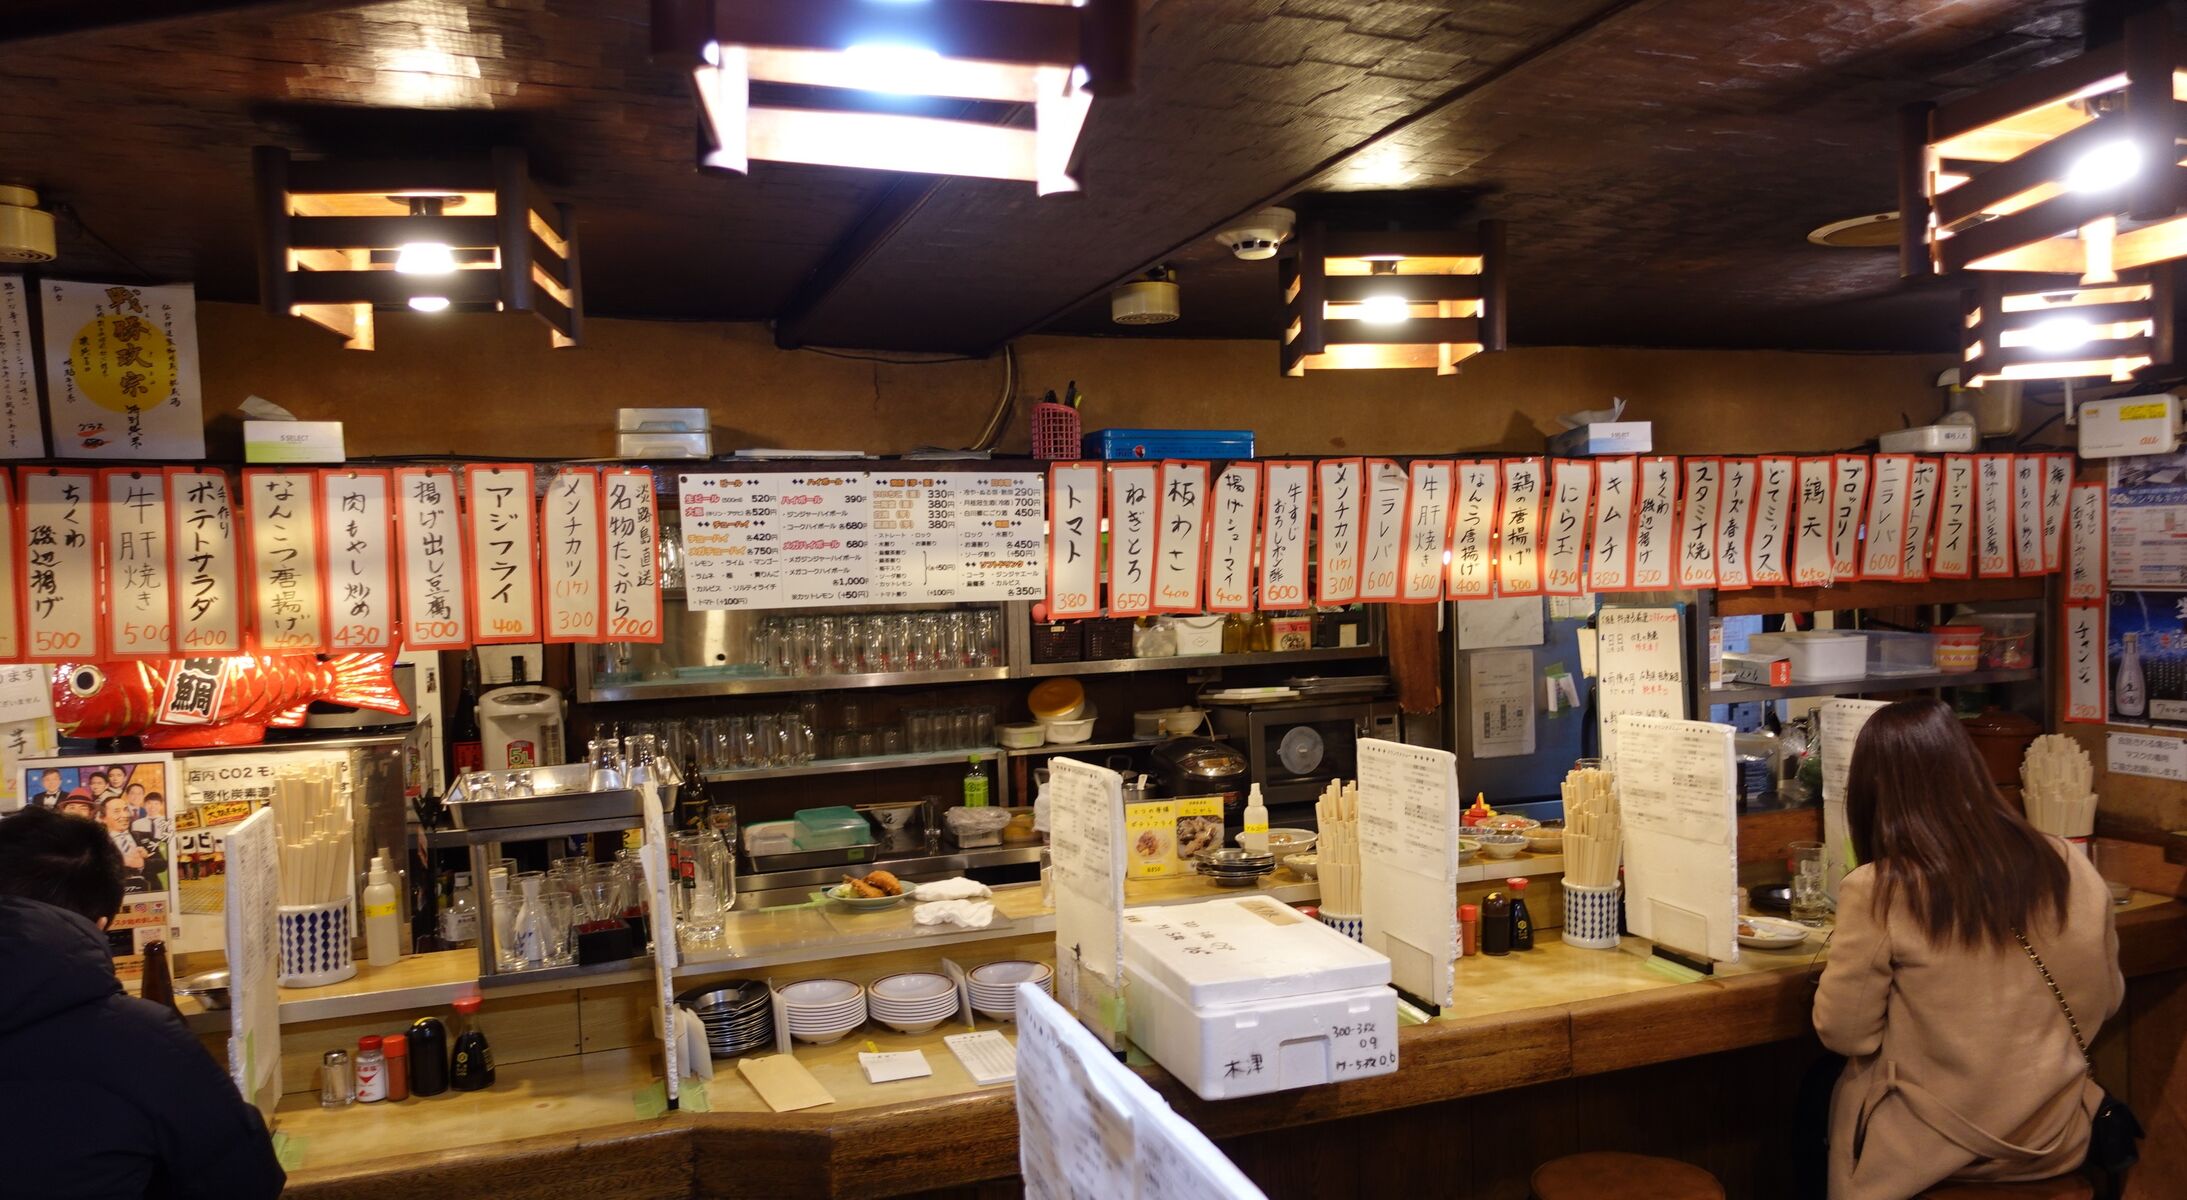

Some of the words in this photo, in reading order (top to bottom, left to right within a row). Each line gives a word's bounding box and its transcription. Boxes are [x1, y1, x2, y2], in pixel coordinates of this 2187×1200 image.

[720, 479, 743, 487] ビール
[1014, 488, 1041, 497] 290円
[1656, 468, 1670, 516] ちくわ
[751, 494, 776, 503] 520円
[844, 495, 867, 503] 390円
[928, 490, 955, 499] 330円
[928, 500, 955, 509] 380円
[1015, 499, 1041, 507] 700円
[217, 486, 229, 539] 手作り
[928, 510, 955, 519] 330円
[1015, 509, 1041, 517] 450円
[1287, 483, 1303, 542] 牛すじ
[1334, 467, 1350, 556] メンチカツ
[1686, 466, 1713, 561] スタミナ焼
[1803, 477, 1826, 538] 鶏天
[1836, 467, 1864, 556] ブロッコリー
[1873, 467, 1899, 544] ニラレバ
[1946, 467, 1968, 551] アジフライ
[62, 484, 86, 548] ちくわ
[928, 520, 955, 529] 380円
[1065, 485, 1082, 564] トマト
[1168, 478, 1196, 571] 板わさ
[1372, 474, 1400, 562] ニラレバ
[1415, 475, 1441, 567] 牛肝焼き
[1460, 472, 1486, 576] なんこつ唐揚げ
[1507, 472, 1535, 565] 鶏の唐揚げ
[1553, 484, 1579, 556] にら玉
[1600, 477, 1623, 563] キムチ
[1722, 471, 1744, 565] チーズ春巻
[1758, 468, 1785, 572] どてミックス
[1904, 466, 1934, 569] ポテトフライ
[564, 479, 583, 576] メンチカツ
[635, 483, 654, 587] 淡路島直送
[1125, 483, 1148, 584] ねぎとろ
[1224, 473, 1246, 589] 揚げシューマイ
[119, 486, 161, 612] 牛肝焼き
[187, 481, 219, 622] ポテトサラダ
[414, 480, 450, 620] 揚げ出し豆腐
[486, 486, 518, 604] アジフライ
[846, 541, 868, 549] 680円
[1269, 499, 1288, 584] おろしポン酢
[265, 480, 310, 631] なんこつ唐揚げ
[342, 494, 370, 617] 肉もやし炒め
[609, 484, 635, 620] 名物たこから
[753, 558, 779, 566] マンゴー
[1869, 554, 1897, 570] 600
[29, 525, 63, 619] 磯辺揚げ
[725, 559, 744, 567] ライム
[1979, 556, 2004, 570] 500
[1368, 571, 1394, 590] 600
[1412, 574, 1437, 591] 500
[1549, 568, 1577, 585] 430
[1593, 569, 1620, 585] 380
[1636, 569, 1662, 582] 500
[1684, 566, 1714, 581] 600
[1800, 568, 1826, 580] 450
[1162, 585, 1190, 598] 400
[1267, 585, 1299, 600] 600
[1329, 575, 1354, 595] 300
[1456, 578, 1481, 592] 400
[1510, 579, 1532, 590] 500
[1057, 592, 1087, 610] 380
[1117, 592, 1148, 610] 650
[1216, 588, 1242, 602] 400
[416, 621, 458, 640] 500
[493, 618, 522, 633] 400
[558, 611, 593, 631] 300
[36, 631, 80, 651] 500
[124, 624, 170, 645] 500
[184, 630, 228, 646] 400
[274, 633, 314, 647] 400
[334, 624, 379, 645] 430
[188, 769, 218, 782] 店内
[219, 766, 253, 781] CO2
[1223, 1053, 1265, 1080] 木津
